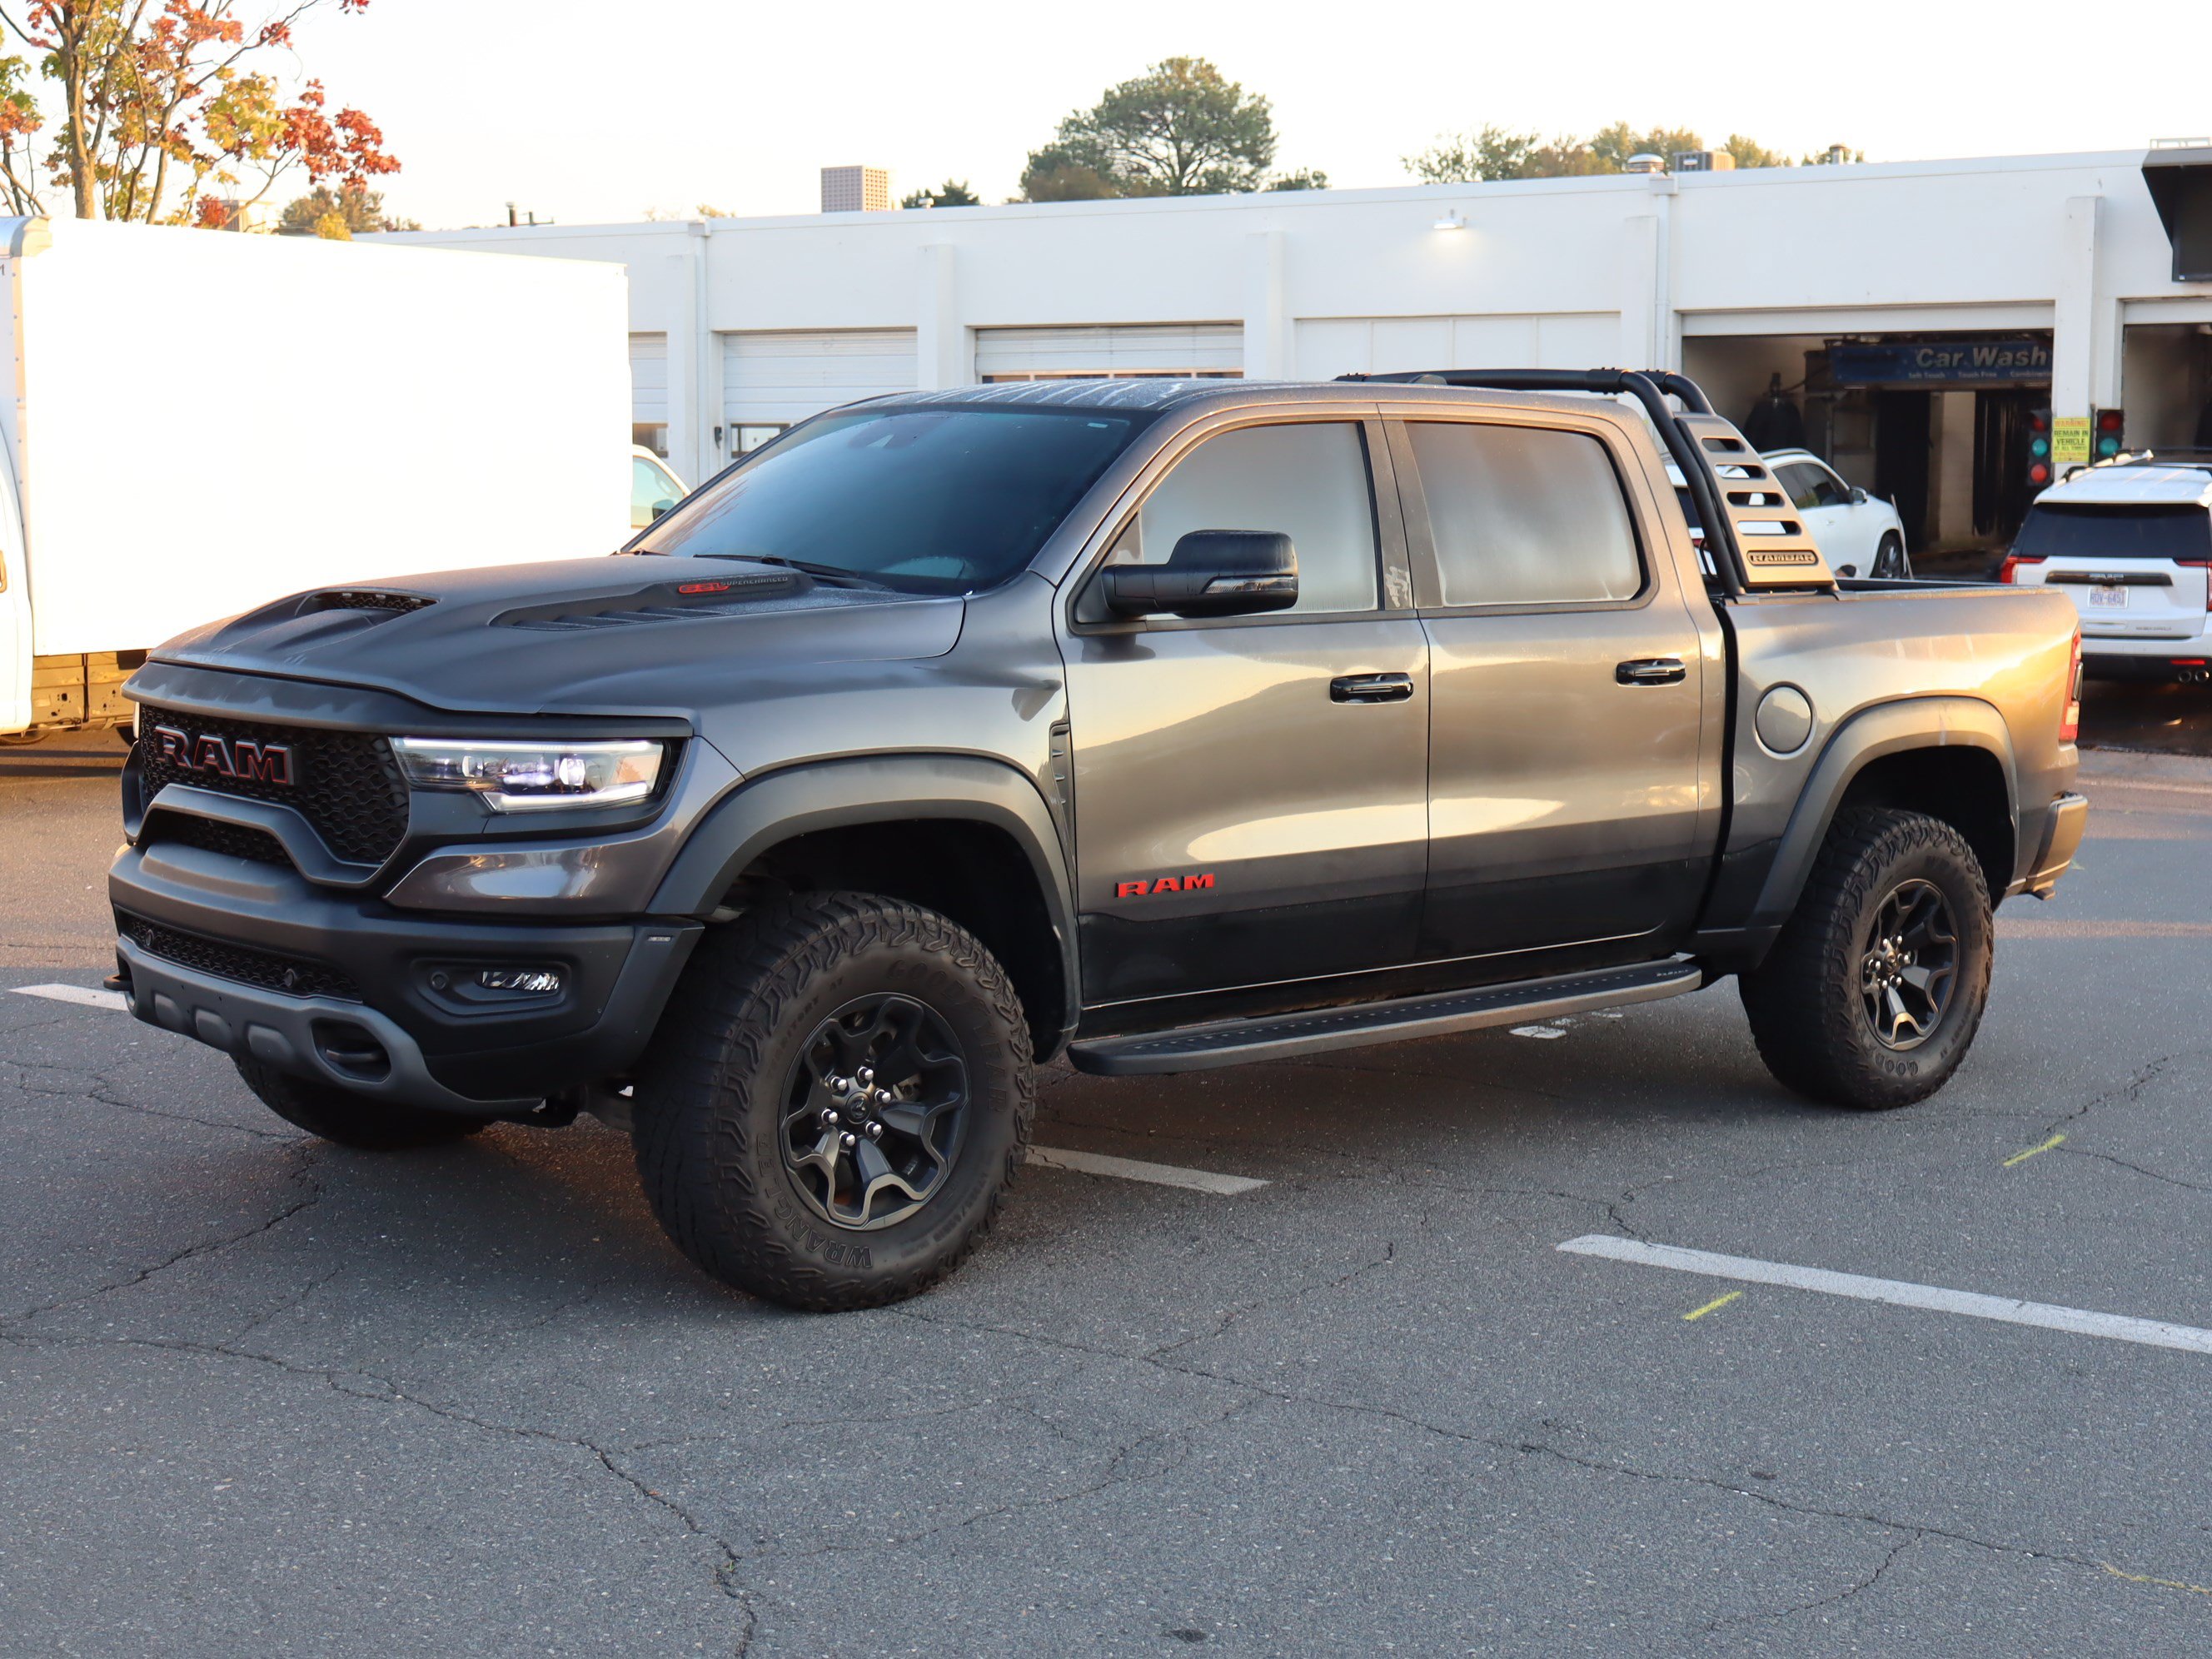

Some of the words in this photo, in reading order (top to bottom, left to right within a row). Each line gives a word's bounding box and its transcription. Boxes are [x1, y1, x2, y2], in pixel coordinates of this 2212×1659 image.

[1916, 348, 1964, 368] Car
[1973, 346, 2047, 367] Wash
[720, 576, 789, 586] SUPERCHARGED
[155, 725, 294, 785] RAM
[1115, 874, 1215, 899] RAM
[756, 1132, 874, 1268] WRANGLER
